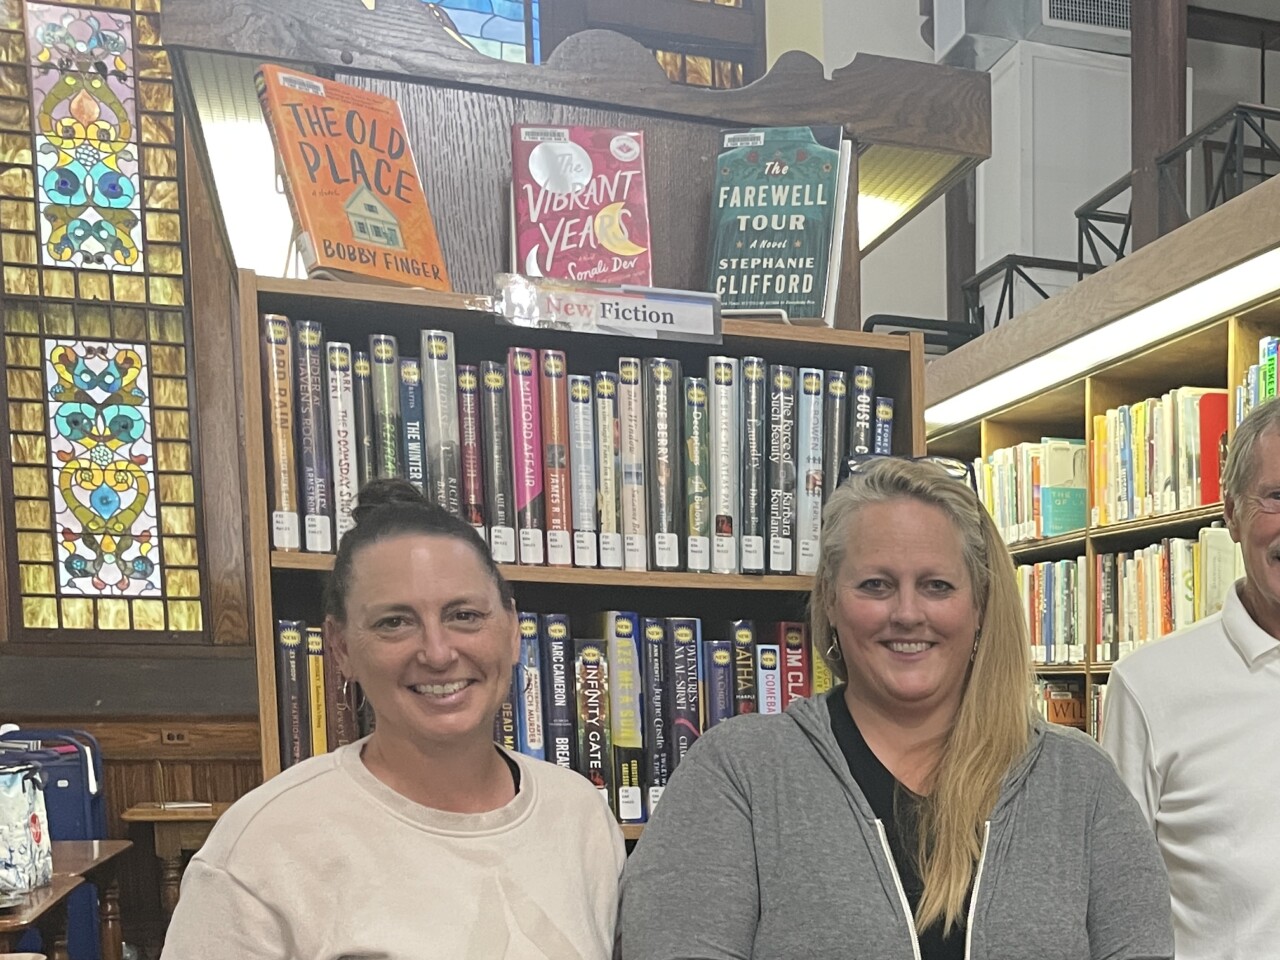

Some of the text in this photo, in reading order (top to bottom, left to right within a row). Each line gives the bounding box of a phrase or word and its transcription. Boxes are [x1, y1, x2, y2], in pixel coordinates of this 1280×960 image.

[281, 103, 405, 160] THE OLD
[298, 141, 415, 204] PLACE
[558, 153, 584, 173] The
[764, 161, 789, 175] The
[523, 170, 641, 223] VIBRANT
[718, 183, 828, 209] FAREWELL
[539, 209, 632, 272] YEARS
[737, 214, 805, 231] TOUR
[323, 239, 443, 282] BOBBY FINGER
[718, 257, 815, 270] STEPHANIE
[750, 239, 788, 249] A Novel
[564, 261, 609, 281] Sonali
[611, 256, 638, 273] Dev
[716, 273, 813, 296] CLIFFORD
[545, 298, 674, 325] New Fiction
[769, 393, 782, 463] Such Beauty
[783, 394, 793, 464] The Force of
[857, 395, 870, 429] OUSE
[407, 421, 423, 480] THE WINTER
[522, 381, 535, 488] MITFORD AFFAIR
[657, 422, 669, 464] BERRY
[306, 467, 316, 515] ARMSTRON
[782, 491, 793, 536] Barbara
[553, 666, 566, 706] CAMERON
[686, 643, 698, 700] DVENTURES
[765, 674, 776, 713] COMEBA
[502, 703, 514, 750] DEAD MA
[528, 709, 536, 743] MURDER
[653, 684, 665, 749] Jayne Castle
[589, 731, 602, 769] GATE
